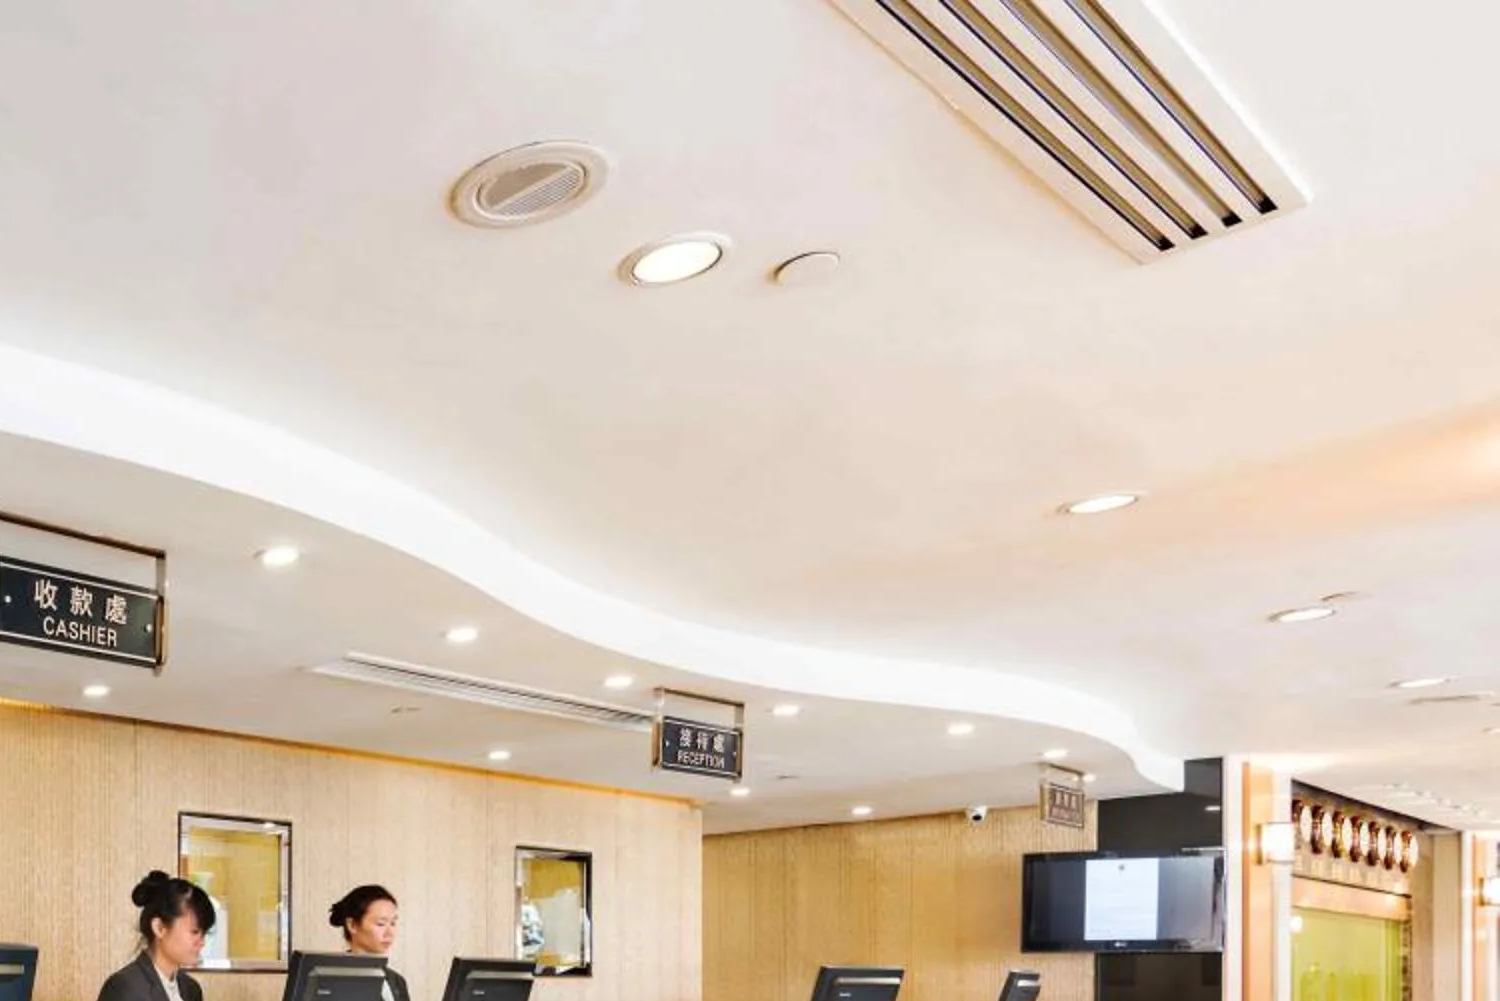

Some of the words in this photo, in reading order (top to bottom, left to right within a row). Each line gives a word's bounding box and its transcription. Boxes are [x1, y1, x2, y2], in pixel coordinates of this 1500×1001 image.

[34, 579, 127, 624] 收款處
[43, 617, 117, 647] CASHIER
[677, 749, 725, 769] RECEPTION
